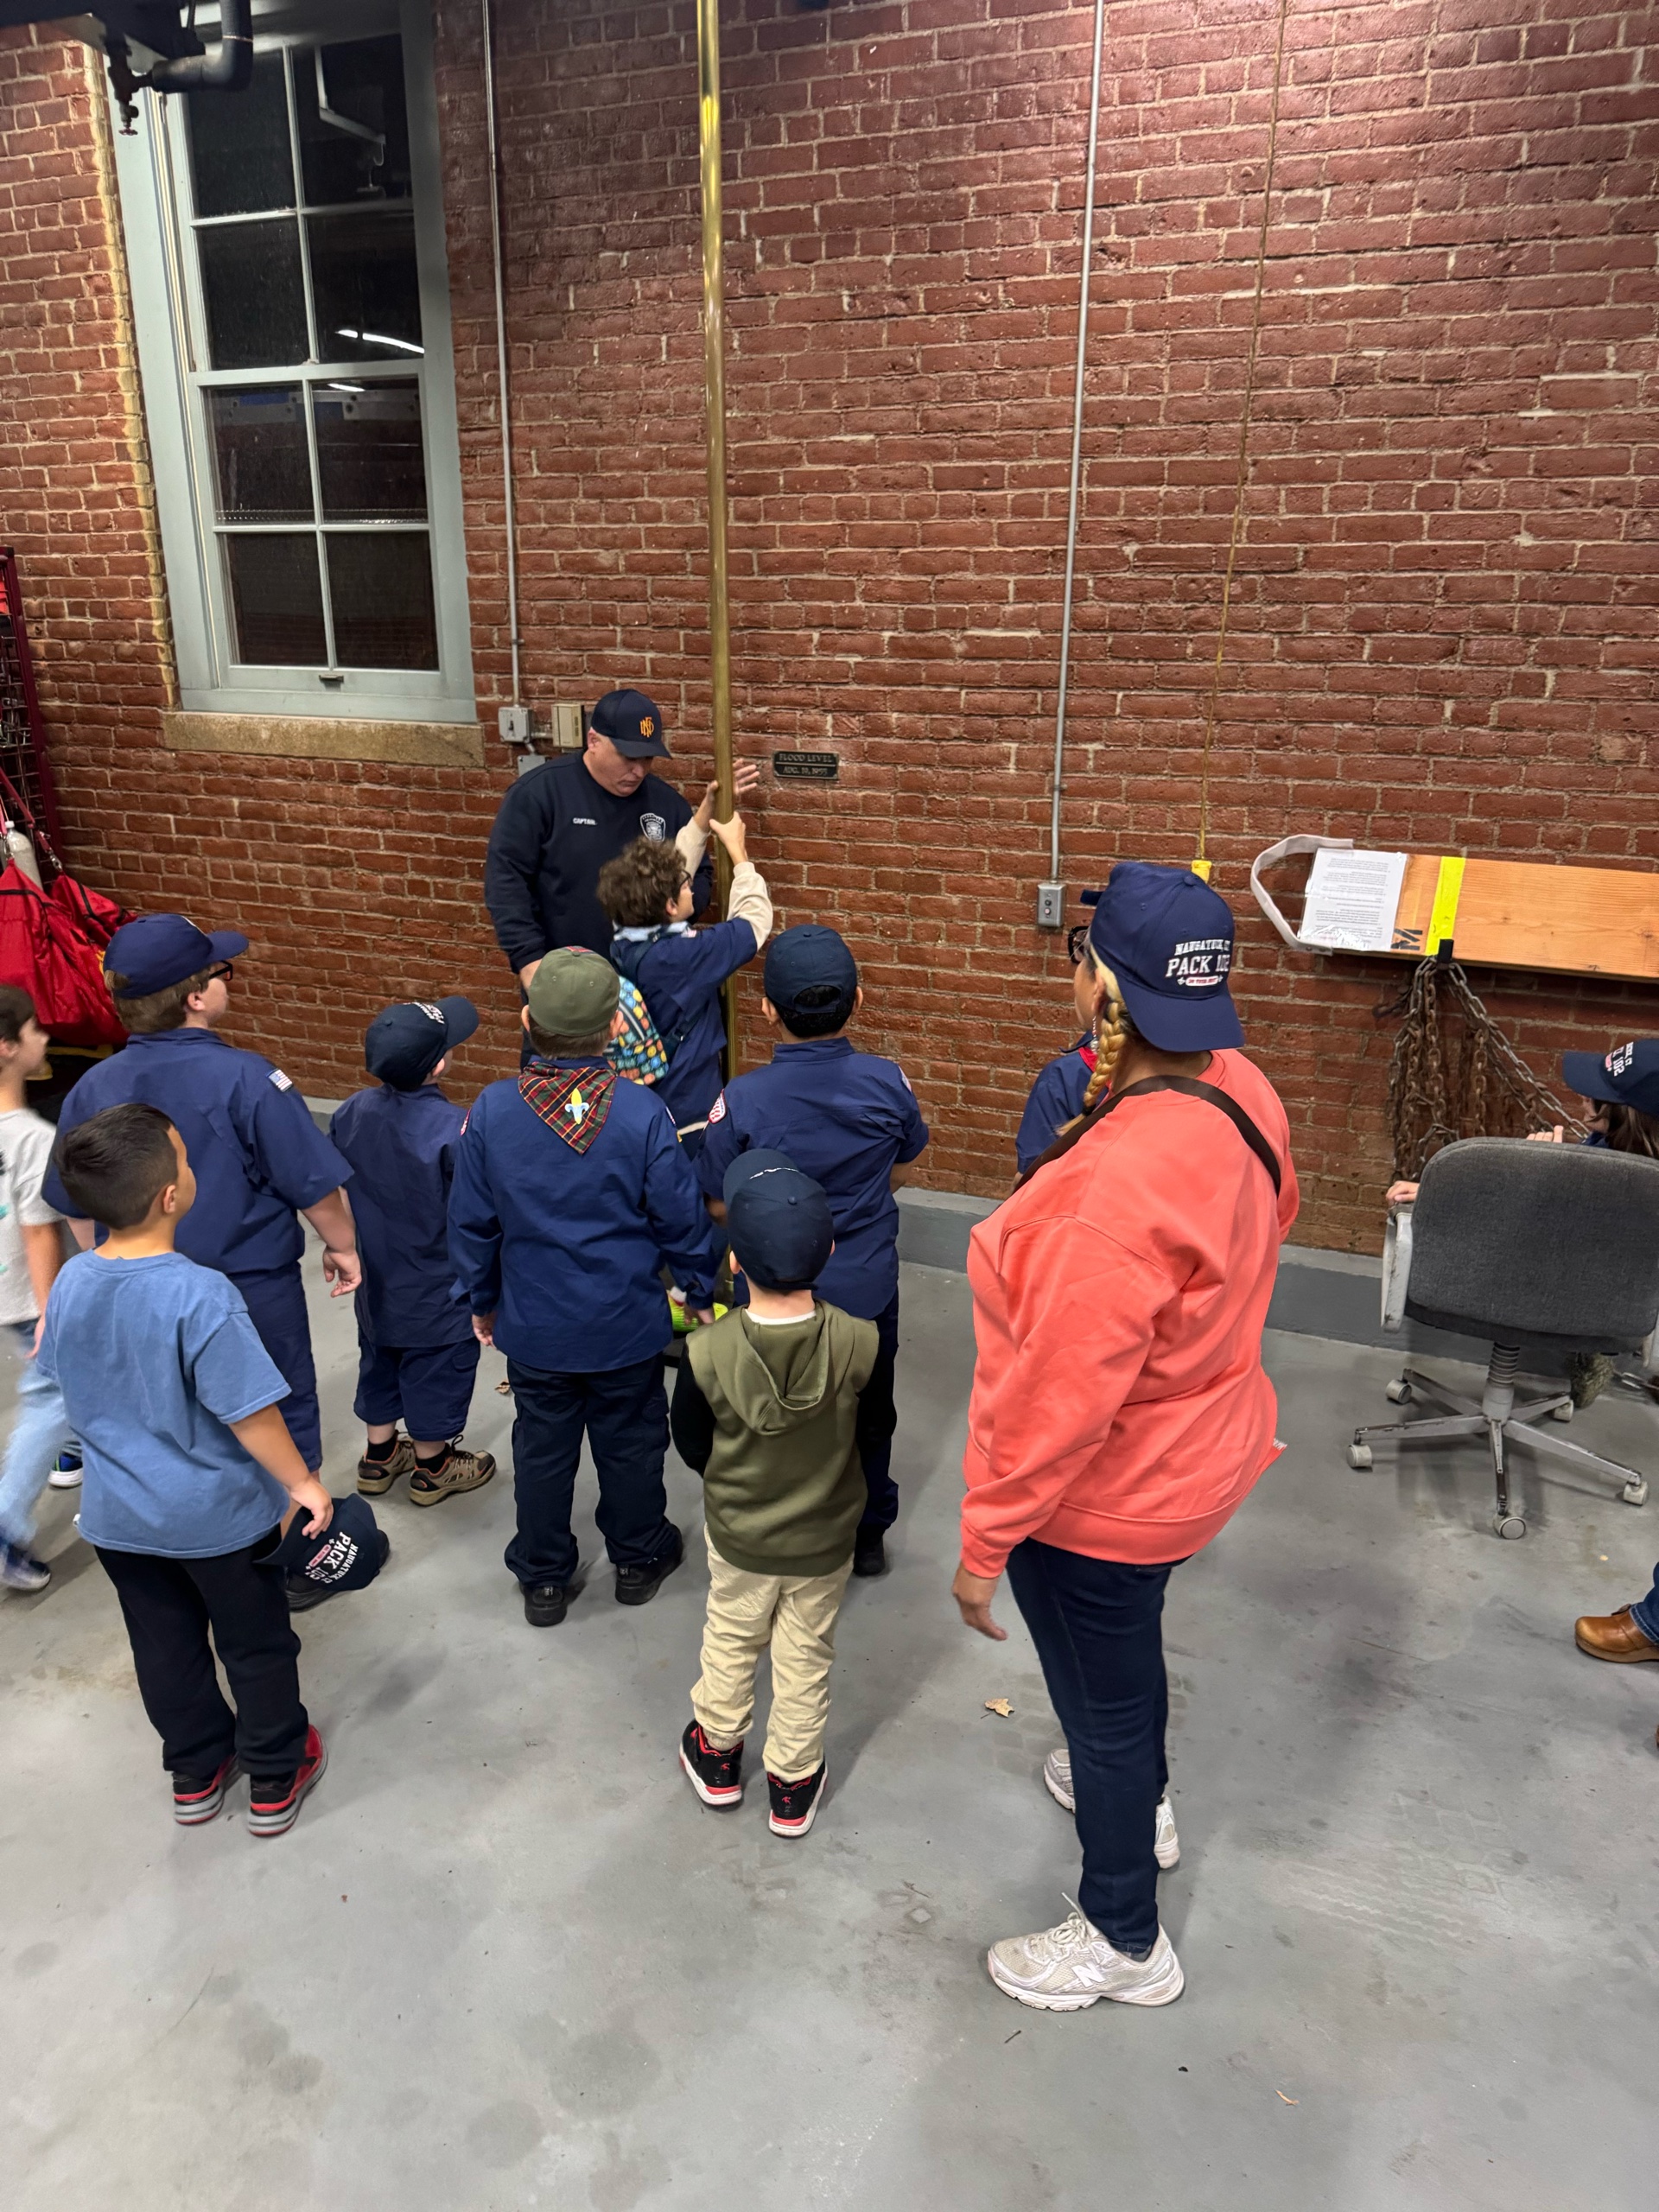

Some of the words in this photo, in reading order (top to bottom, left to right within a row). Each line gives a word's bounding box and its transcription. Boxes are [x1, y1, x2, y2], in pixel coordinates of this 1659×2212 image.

[1165, 956, 1213, 977] PACK
[1612, 1056, 1625, 1077] 102
[323, 1532, 352, 1569] PACK
